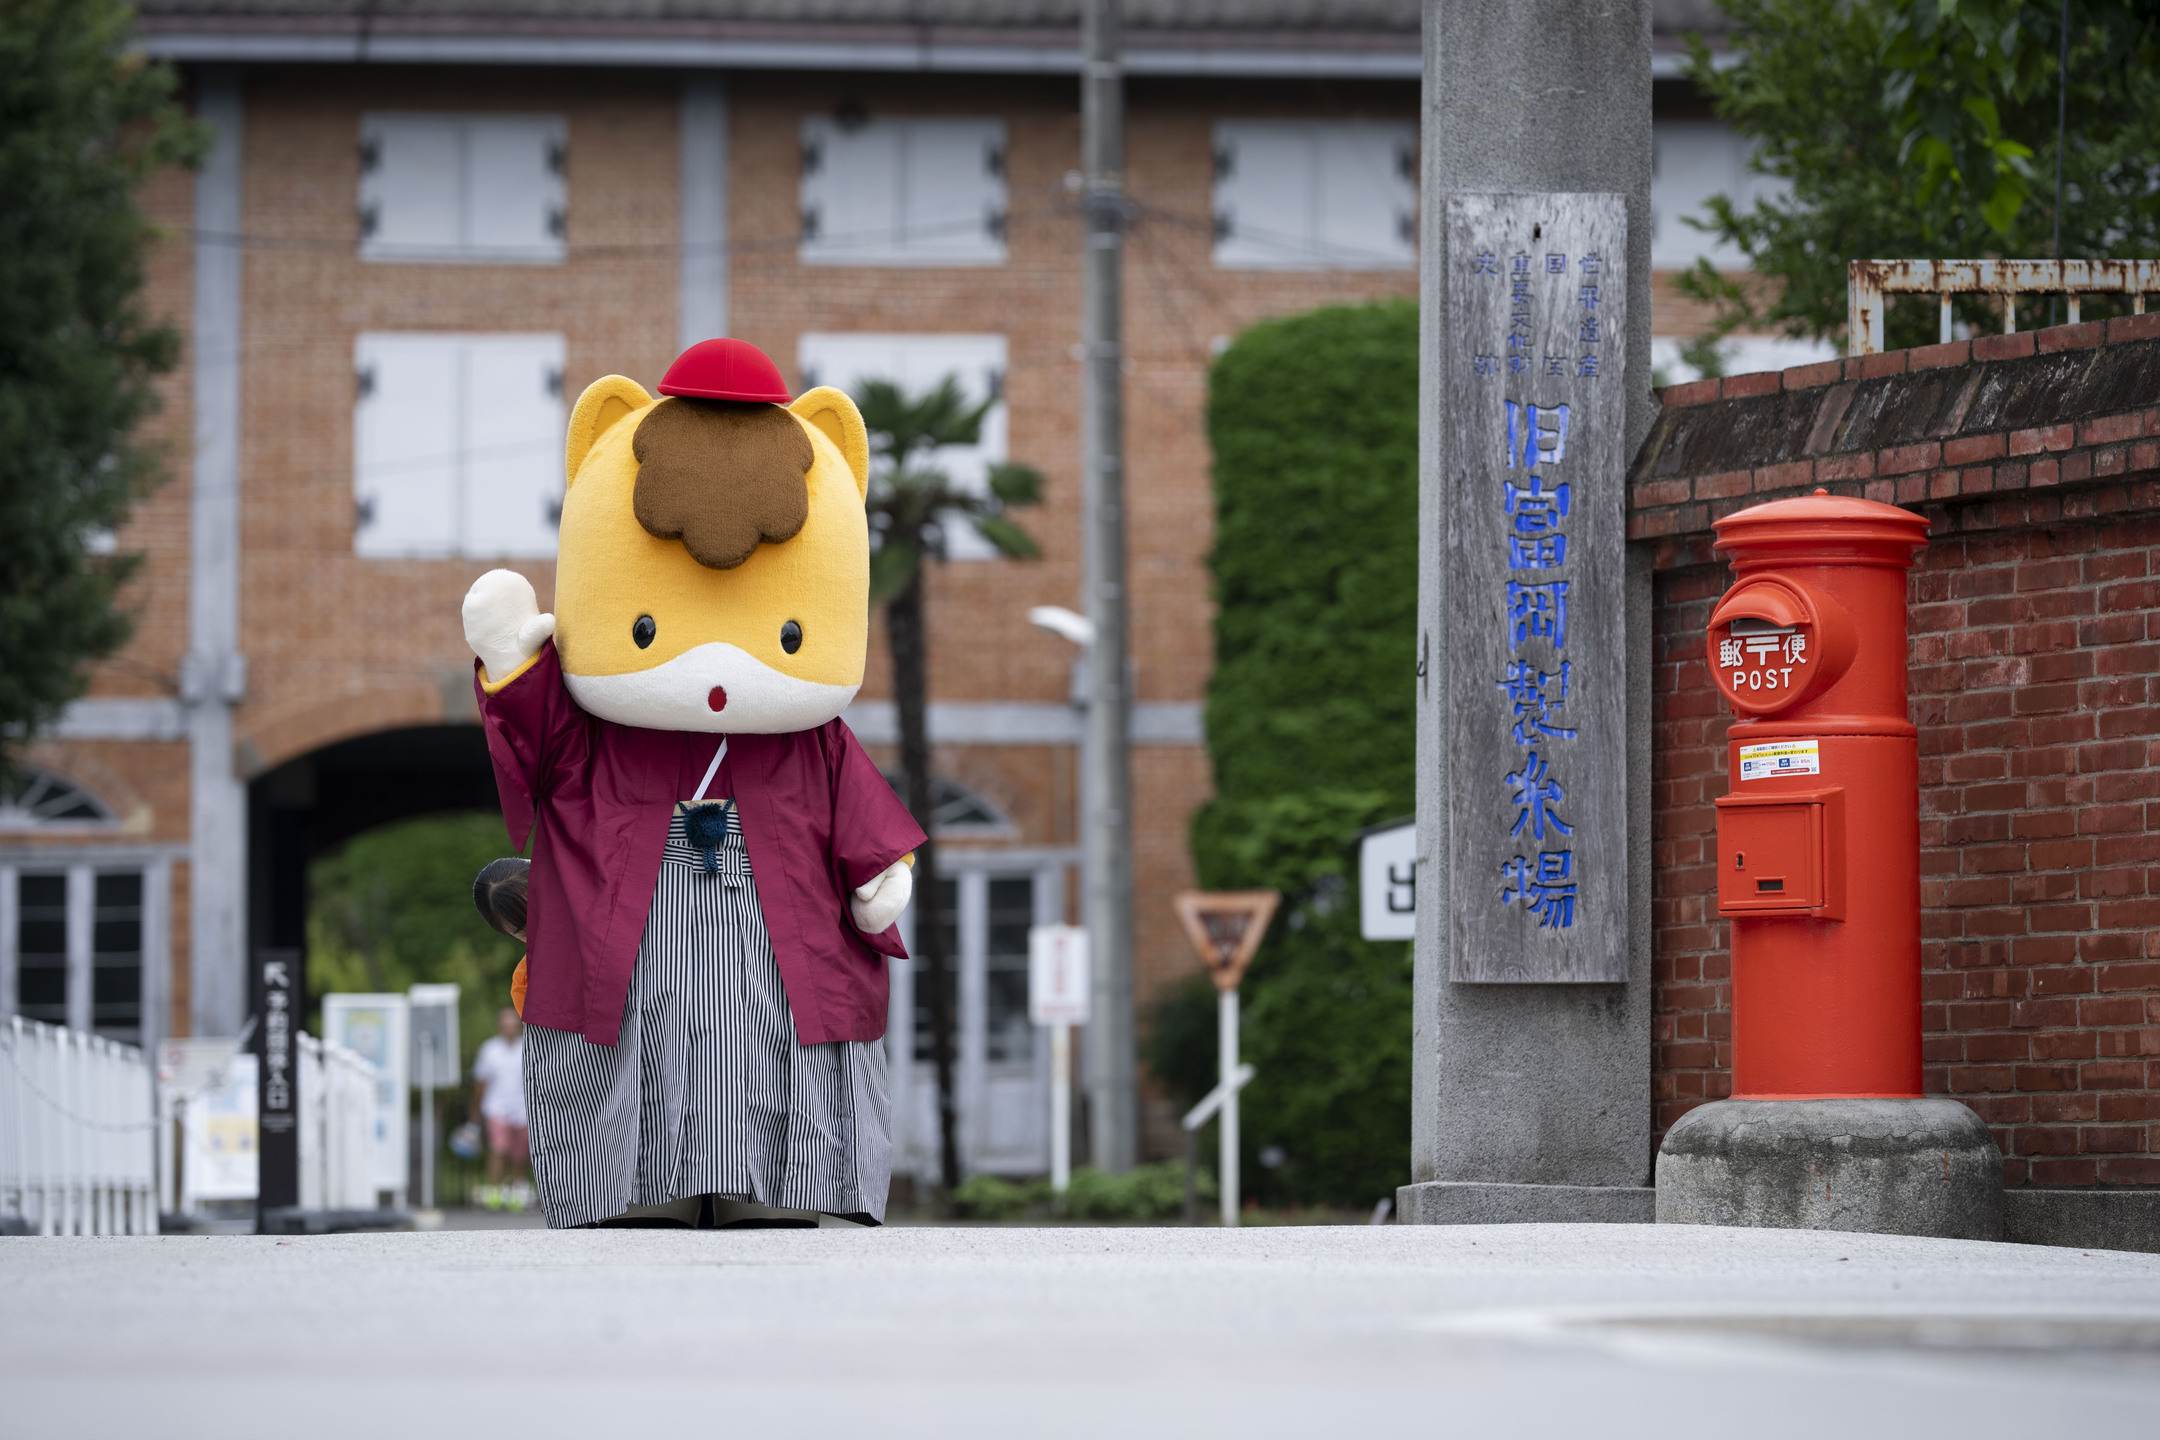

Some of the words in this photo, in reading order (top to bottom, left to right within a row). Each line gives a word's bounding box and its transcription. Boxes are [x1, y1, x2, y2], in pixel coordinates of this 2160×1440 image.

[1473, 251, 1500, 377] 史跡
[1507, 249, 1535, 377] 重要文化財
[1543, 253, 1568, 377] 国宝
[1577, 251, 1603, 379] 世界遺産
[1495, 399, 1578, 929] 旧富岡製糸場
[1733, 667, 1793, 692] POST
